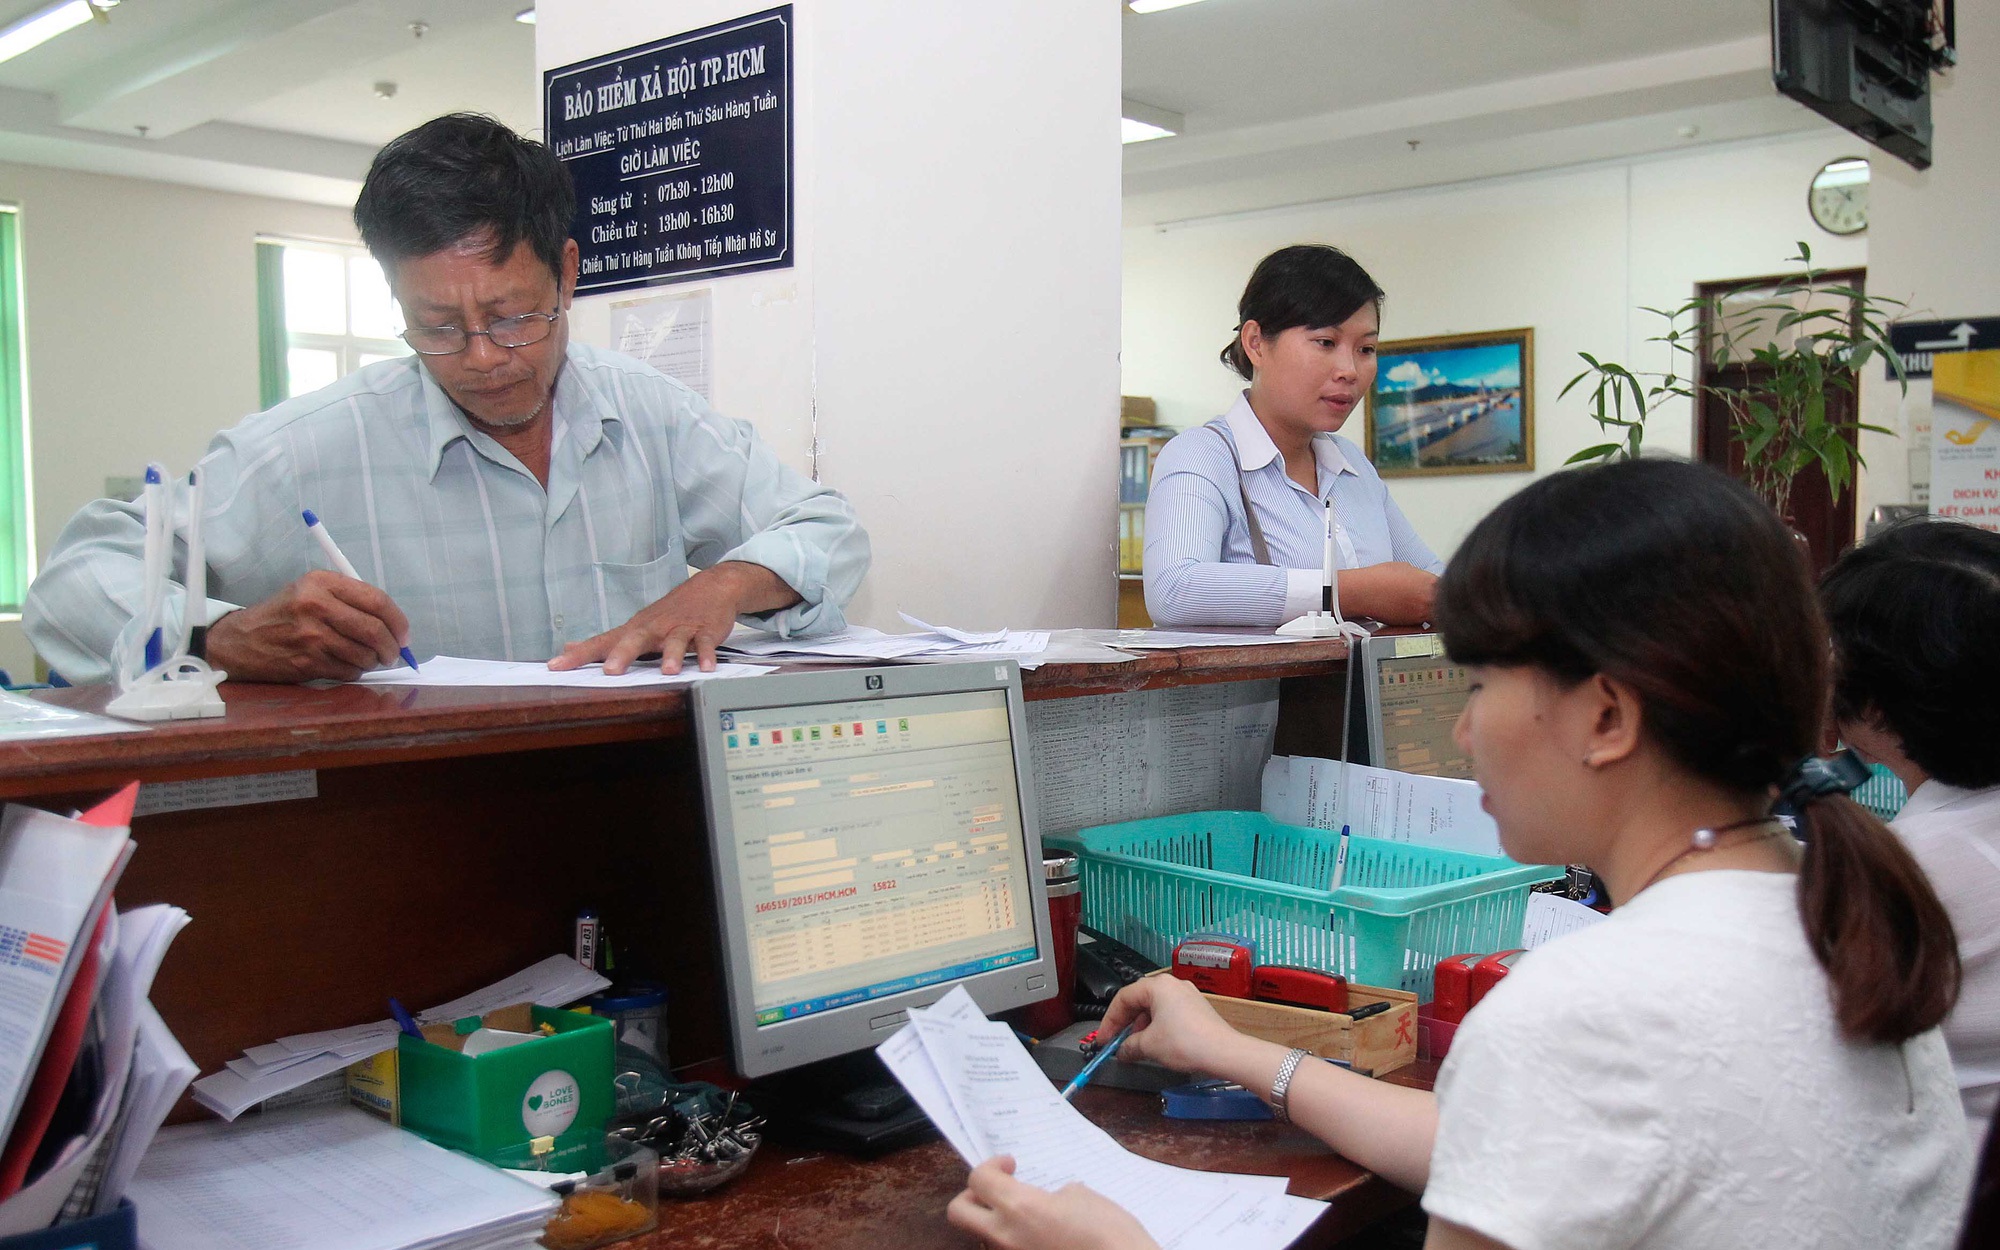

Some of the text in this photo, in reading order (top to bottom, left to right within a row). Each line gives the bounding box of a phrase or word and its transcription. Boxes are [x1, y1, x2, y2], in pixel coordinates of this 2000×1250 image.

[564, 45, 765, 121] BẢO HIỂM XÃ HỘI TP.HCM
[556, 89, 777, 158] Lịch Làm Việc: Từ Thứ Hai Đến Thứ Sáu Hàng Tuần
[621, 137, 700, 174] GIỜ LÀM VIỆC
[591, 196, 617, 215] Sáng
[620, 191, 633, 209] từ
[658, 180, 690, 203] 07h30
[701, 172, 734, 195] 12h00
[592, 221, 622, 243] Chiều
[626, 220, 638, 238] từ
[659, 211, 690, 233] 13h00
[701, 203, 734, 225] 16h30
[582, 255, 603, 274] Chiều
[605, 253, 619, 271] Thứ
[621, 252, 631, 268] Tư
[633, 250, 653, 268] Hàng
[655, 243, 674, 263] Tuần
[677, 242, 701, 261] Không
[704, 235, 722, 258] Tiếp
[725, 234, 746, 254] Nhận
[749, 228, 761, 249] Hồ
[764, 229, 776, 247] Sơ
[755, 880, 897, 914] 166519/2015/HCM.HCM 15822
[543, 1094, 573, 1109] BONES
[550, 1085, 573, 1098] LOVE
